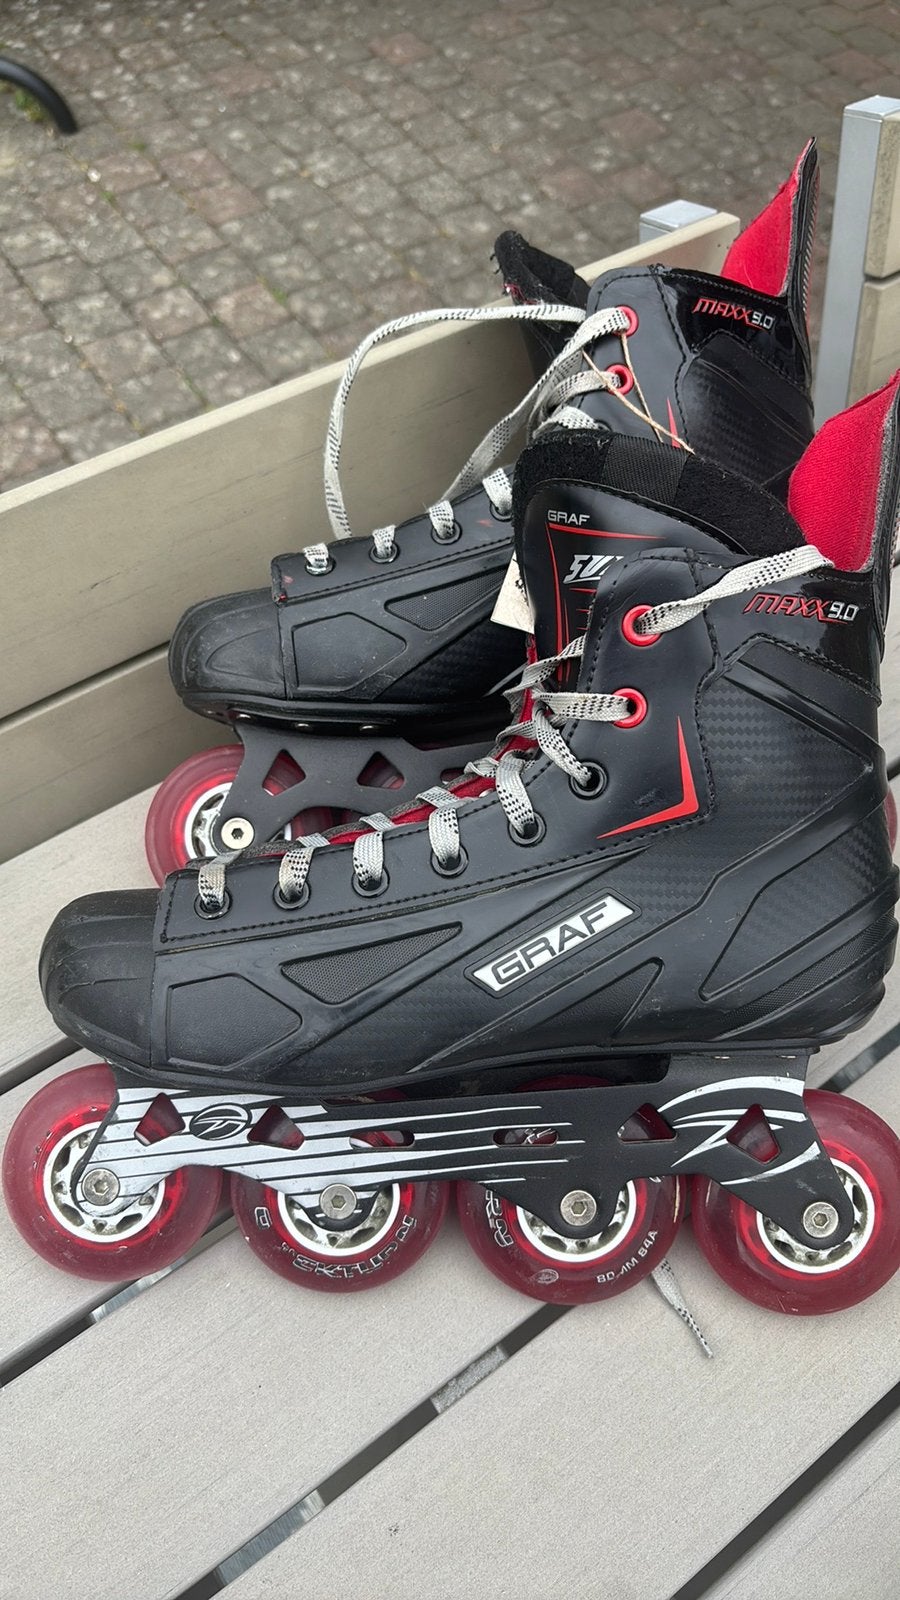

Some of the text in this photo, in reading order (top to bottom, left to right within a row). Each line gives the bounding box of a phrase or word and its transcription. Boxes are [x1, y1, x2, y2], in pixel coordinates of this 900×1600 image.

[547, 510, 591, 526] GRAF
[491, 901, 608, 985] GRAF
[638, 1229, 658, 1258] 84A
